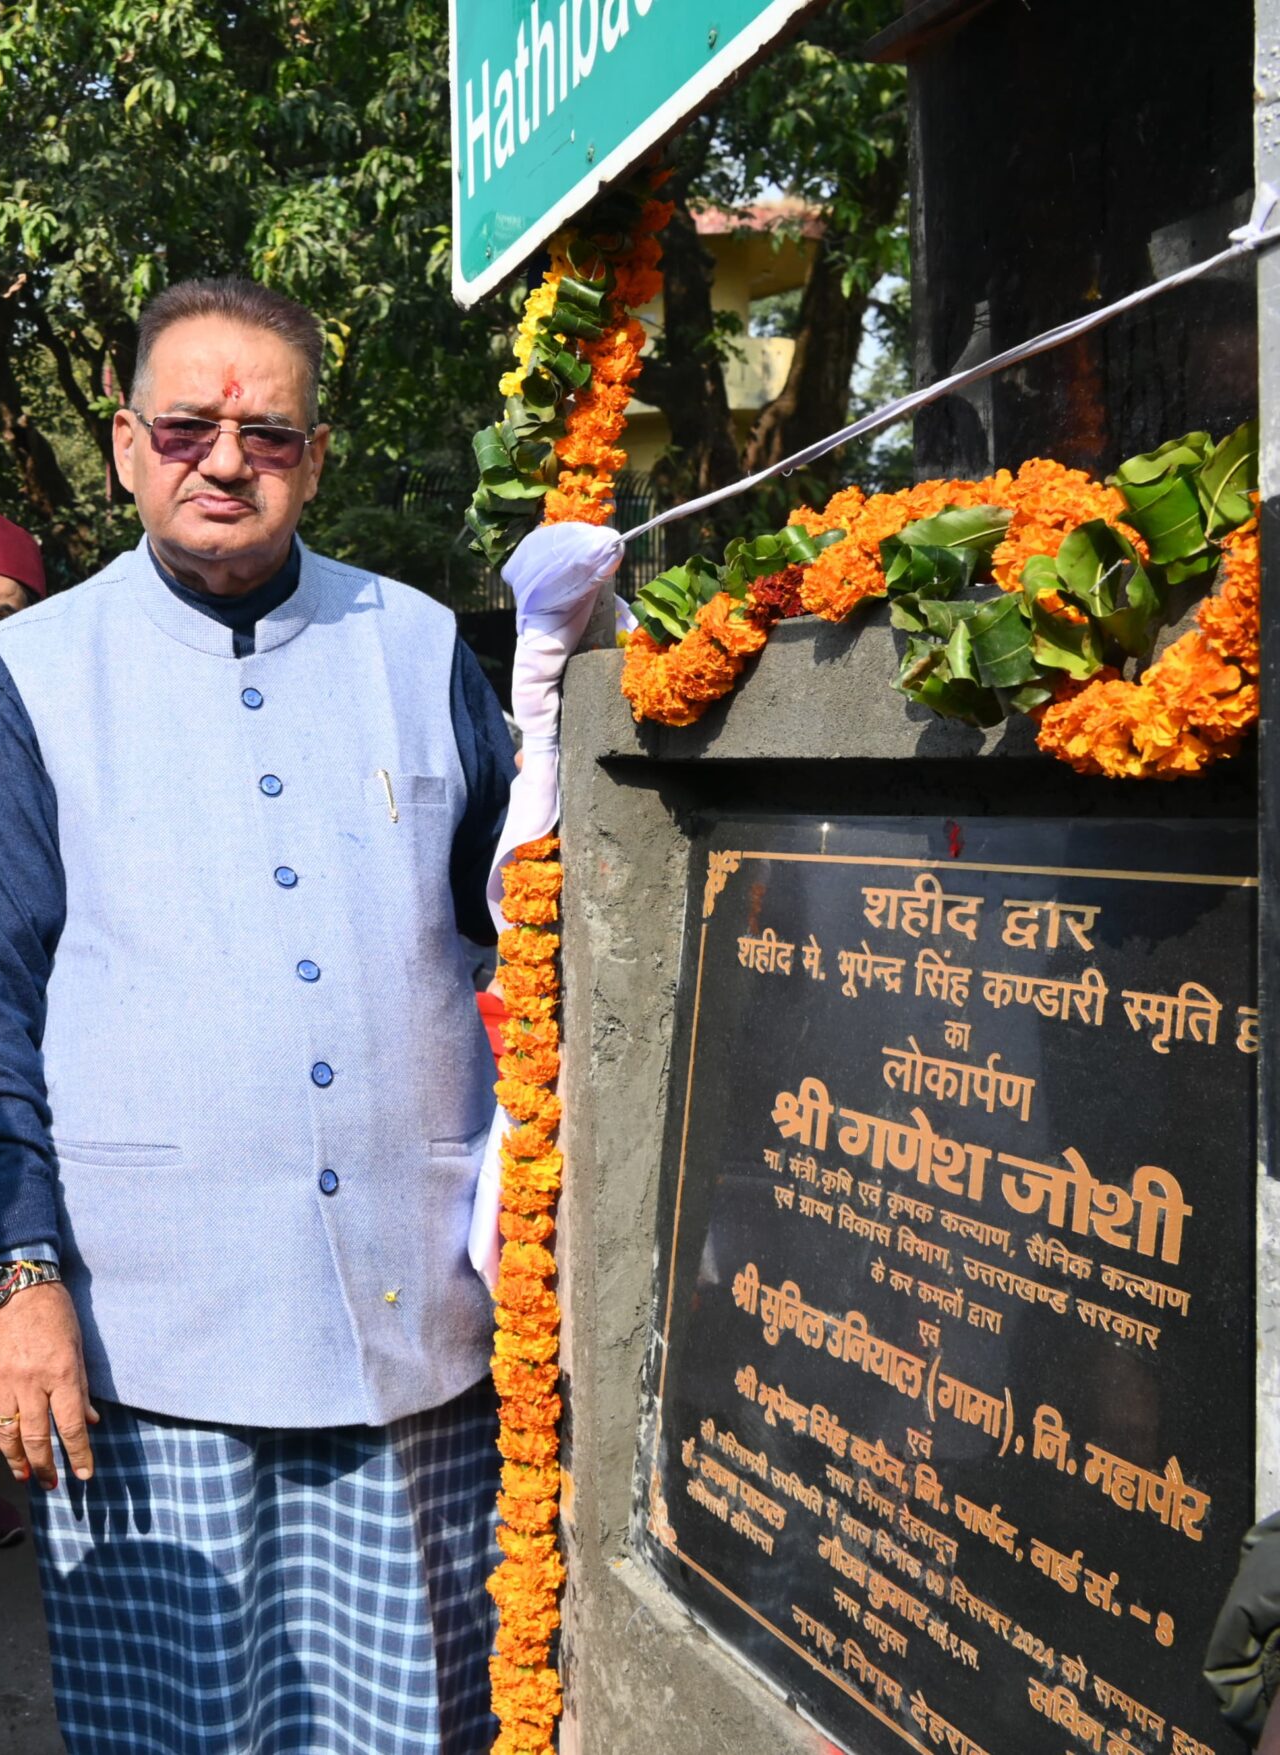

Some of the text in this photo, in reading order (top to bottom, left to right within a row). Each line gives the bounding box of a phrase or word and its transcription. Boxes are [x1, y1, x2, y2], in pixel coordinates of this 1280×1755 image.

[862, 873, 1101, 951] शहीद द्वार
[737, 928, 795, 975] शहीद
[802, 934, 826, 980] मे.
[838, 940, 906, 998] भूपेन्द्र
[915, 948, 972, 1007] सिंह
[982, 968, 1109, 1026] कण्डारी
[1122, 981, 1222, 1054] स्मृति
[944, 1019, 971, 1051] का
[882, 1035, 1035, 1122] लोकार्पण
[771, 1076, 1193, 1265] श्री गणेश जोशी
[763, 1148, 783, 1173] मा.
[858, 1179, 882, 1207] एवं
[887, 1190, 934, 1223] कृषक
[940, 1209, 1017, 1257] कल्याण,
[1025, 1233, 1093, 1280] सैनिक
[1100, 1264, 1191, 1317] कल्याण
[774, 1184, 1161, 1350] एवं ग्राम्य विकास विभाग, उत्तराखण्ड सरकार
[870, 1256, 1003, 1334] के कर कमलों द्वारा
[918, 1318, 942, 1348] एवं
[732, 1262, 760, 1315] श्री
[826, 1310, 926, 1399] उनियाल
[1033, 1404, 1077, 1475] नि.
[1084, 1442, 1211, 1541] महापौर
[906, 1427, 932, 1460] एवं
[734, 1364, 758, 1401] श्री
[758, 1383, 810, 1433] भूपेन्द्र
[810, 1404, 850, 1457] सिंह
[914, 1463, 950, 1515] नि.
[955, 1494, 1024, 1562] पार्षद,
[1031, 1537, 1084, 1593] वार्ड
[1084, 1568, 1122, 1617] सं.
[1155, 1611, 1175, 1647] 8
[826, 1463, 959, 1566] नगर निगम देहरादून
[833, 1587, 908, 1658] नगर आयुक्त
[841, 1513, 872, 1548] आज
[875, 1528, 922, 1579] दिनांक
[925, 1569, 945, 1597] 09
[950, 1575, 1012, 1640] दिसम्बर
[1012, 1625, 1055, 1669] 2024
[1061, 1654, 1088, 1691] को
[868, 1568, 930, 1631] कुमार
[792, 1604, 838, 1658] नगर
[843, 1638, 903, 1709] निगम
